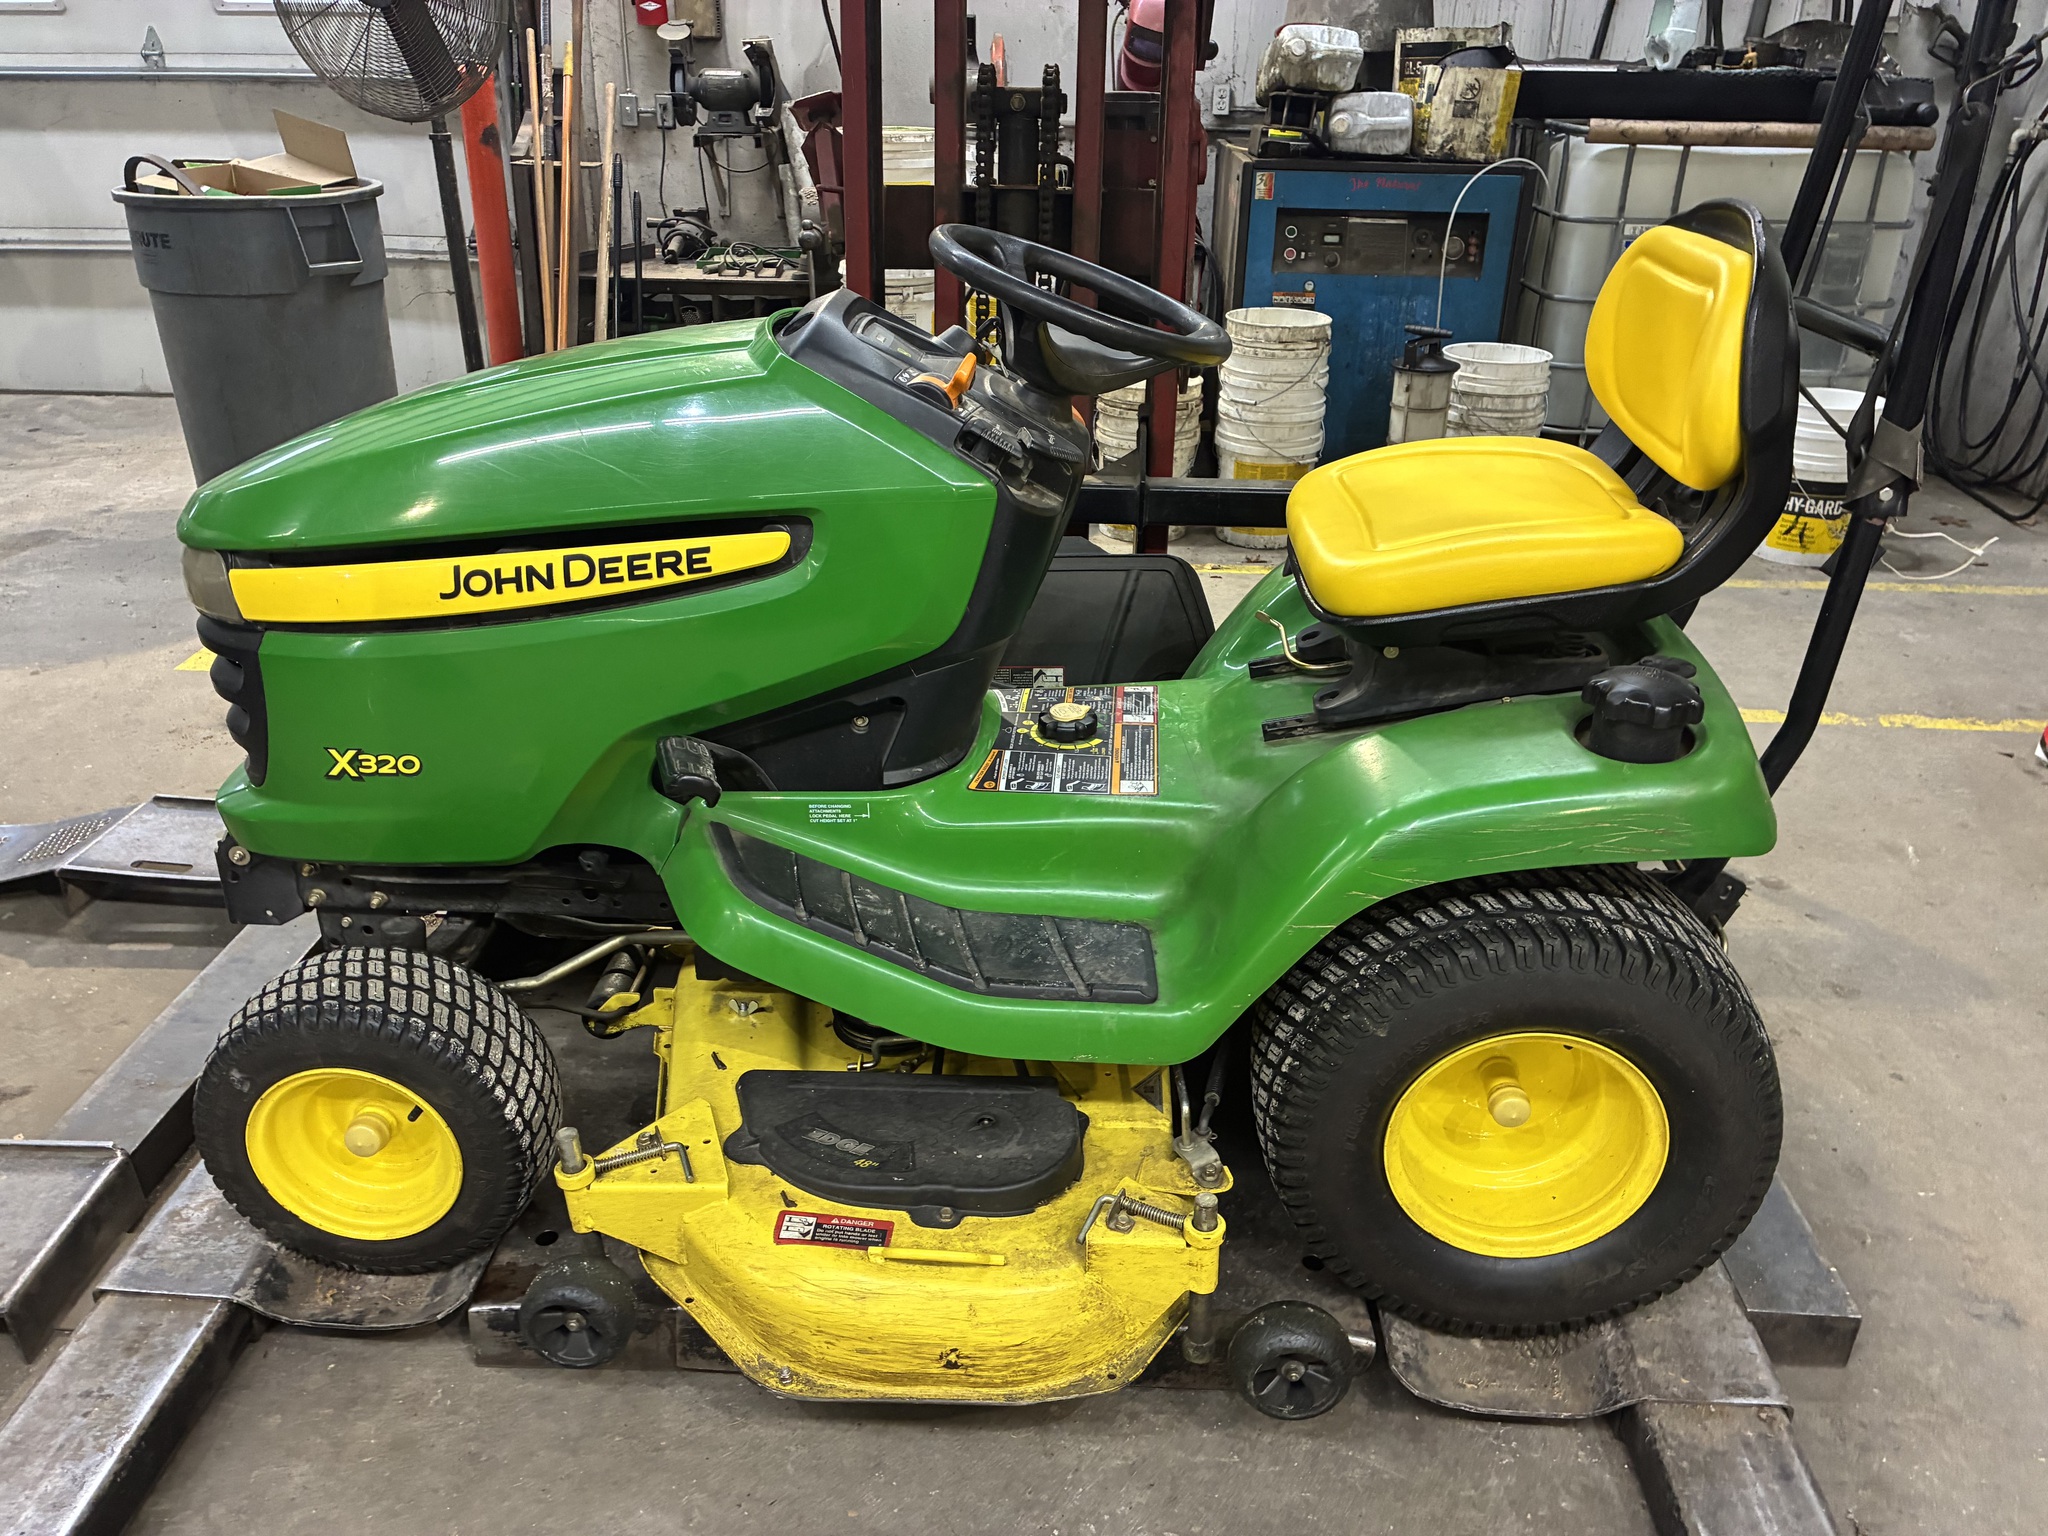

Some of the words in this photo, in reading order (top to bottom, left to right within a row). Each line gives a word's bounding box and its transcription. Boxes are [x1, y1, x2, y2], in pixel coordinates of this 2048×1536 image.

[1784, 496, 1844, 516] HY-GARD
[440, 563, 555, 600] JOHN
[563, 546, 713, 588] DEERE
[325, 747, 422, 780] X320
[823, 1224, 854, 1232] ROTATING
